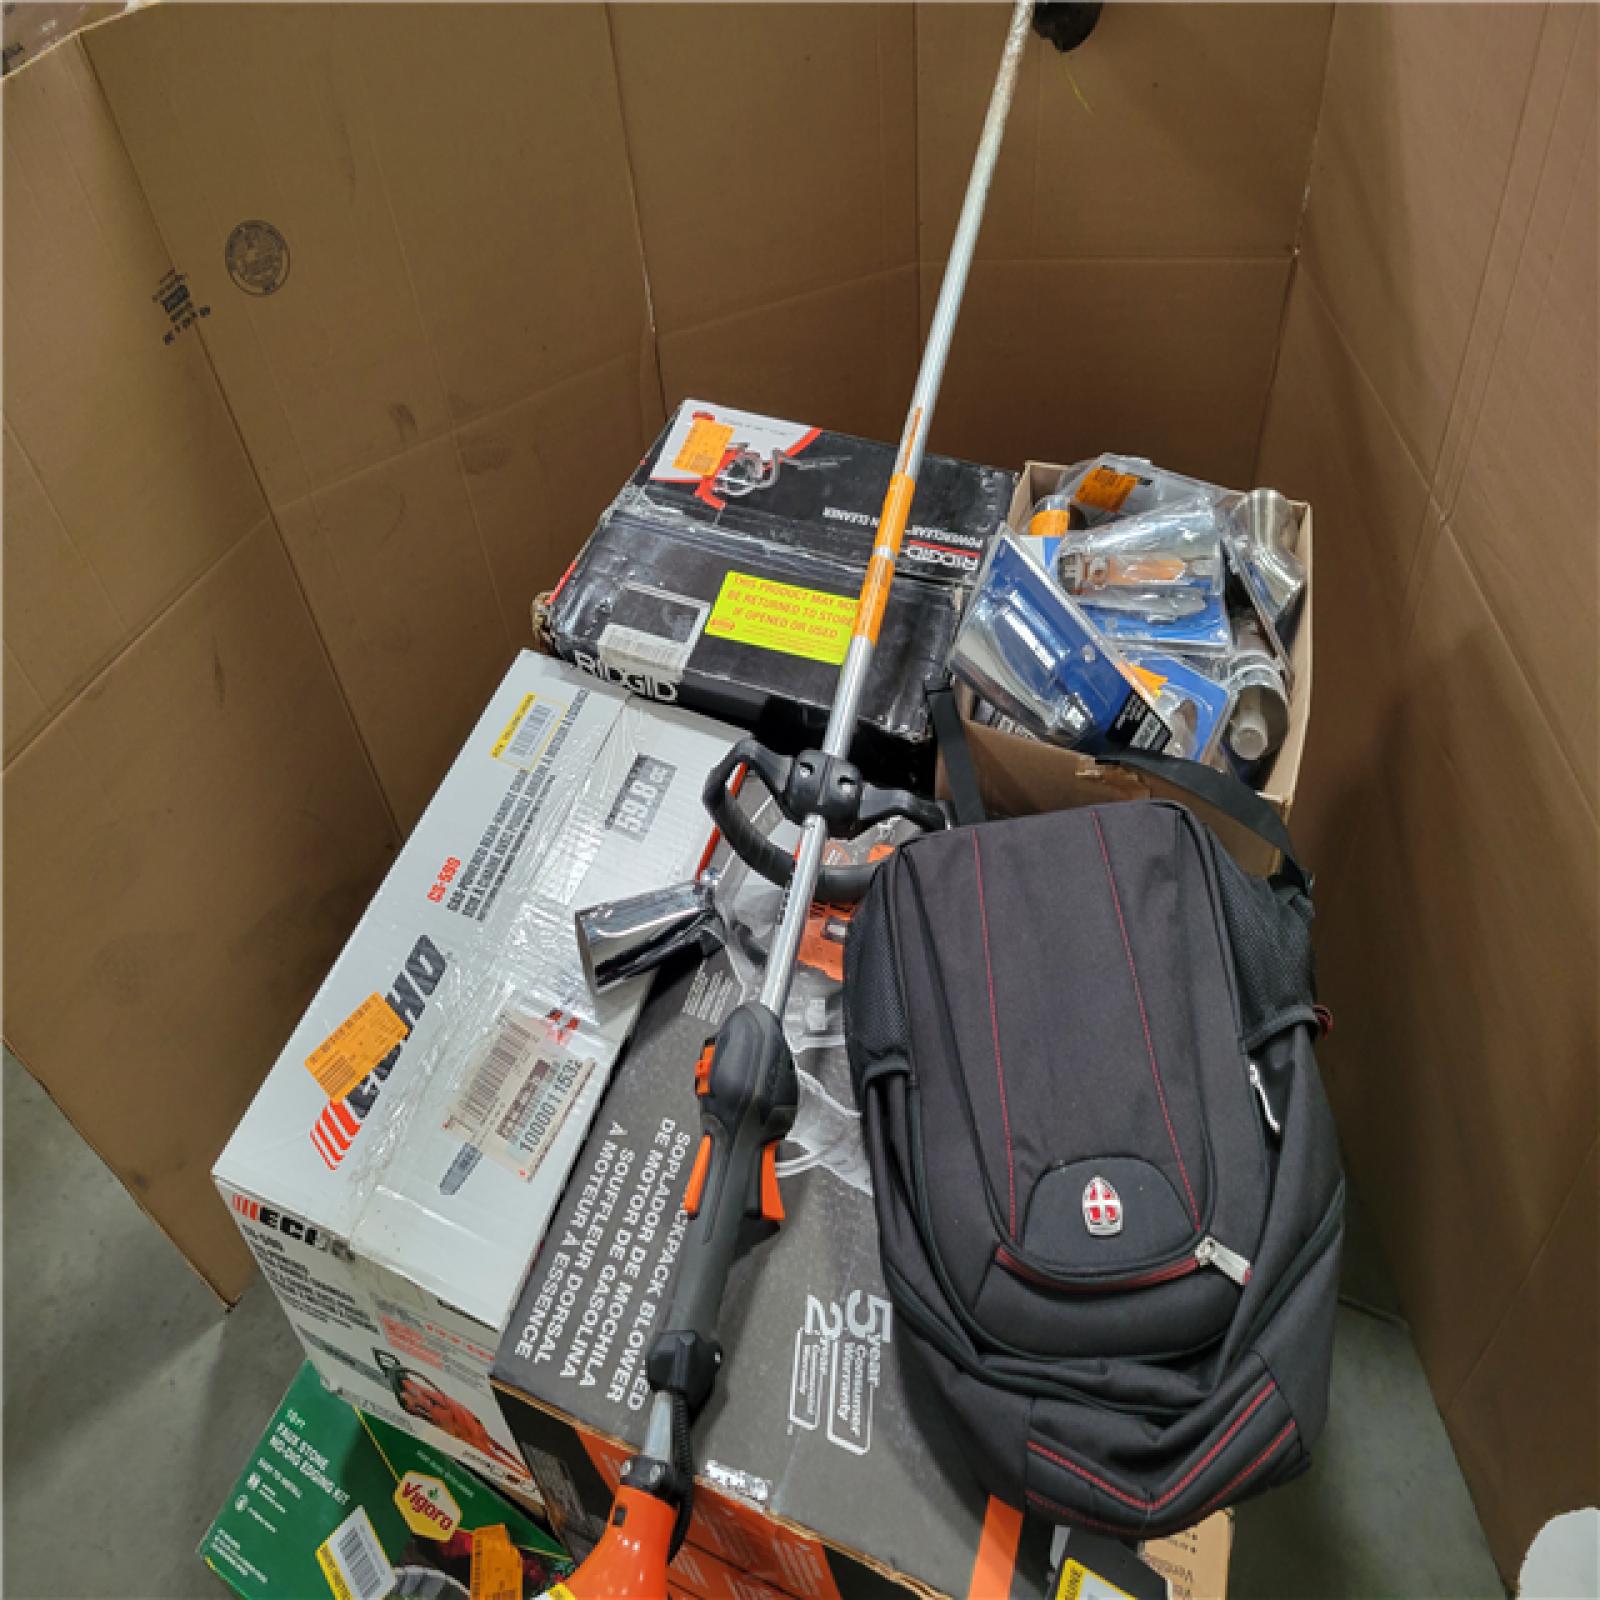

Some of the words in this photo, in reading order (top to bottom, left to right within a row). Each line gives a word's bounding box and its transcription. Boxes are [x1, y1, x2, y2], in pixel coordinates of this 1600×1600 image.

[727, 589, 740, 601] BE
[744, 594, 800, 614] RETURNED
[803, 607, 817, 619] TO
[759, 583, 808, 600] PRODUCT
[811, 593, 834, 606] MAY
[744, 609, 788, 628] OPENED
[808, 623, 838, 639] USED
[655, 1117, 676, 1147] DE
[570, 1140, 618, 1228] MOTEUR
[574, 1147, 636, 1270] SOUFFLEUR
[623, 1149, 663, 1226] MOTOR
[637, 1131, 691, 1244] SOPLADOR
[610, 1227, 632, 1261] DE
[624, 1246, 648, 1279] DE
[514, 1251, 571, 1360] ESSENCE
[533, 1272, 584, 1364] DORSAL
[559, 1264, 617, 1377] GASOLINA
[804, 1294, 843, 1341] 2
[845, 1289, 893, 1343] 5
[579, 1281, 633, 1386] MOCHILA
[604, 1300, 656, 1402] BLOWER
[866, 1333, 882, 1388] year
[837, 1342, 855, 1421] Warranty
[851, 1344, 866, 1438] Consumer
[299, 1441, 329, 1471] STONE
[300, 1460, 335, 1494] EDGING
[402, 1481, 453, 1531] Vigoro
